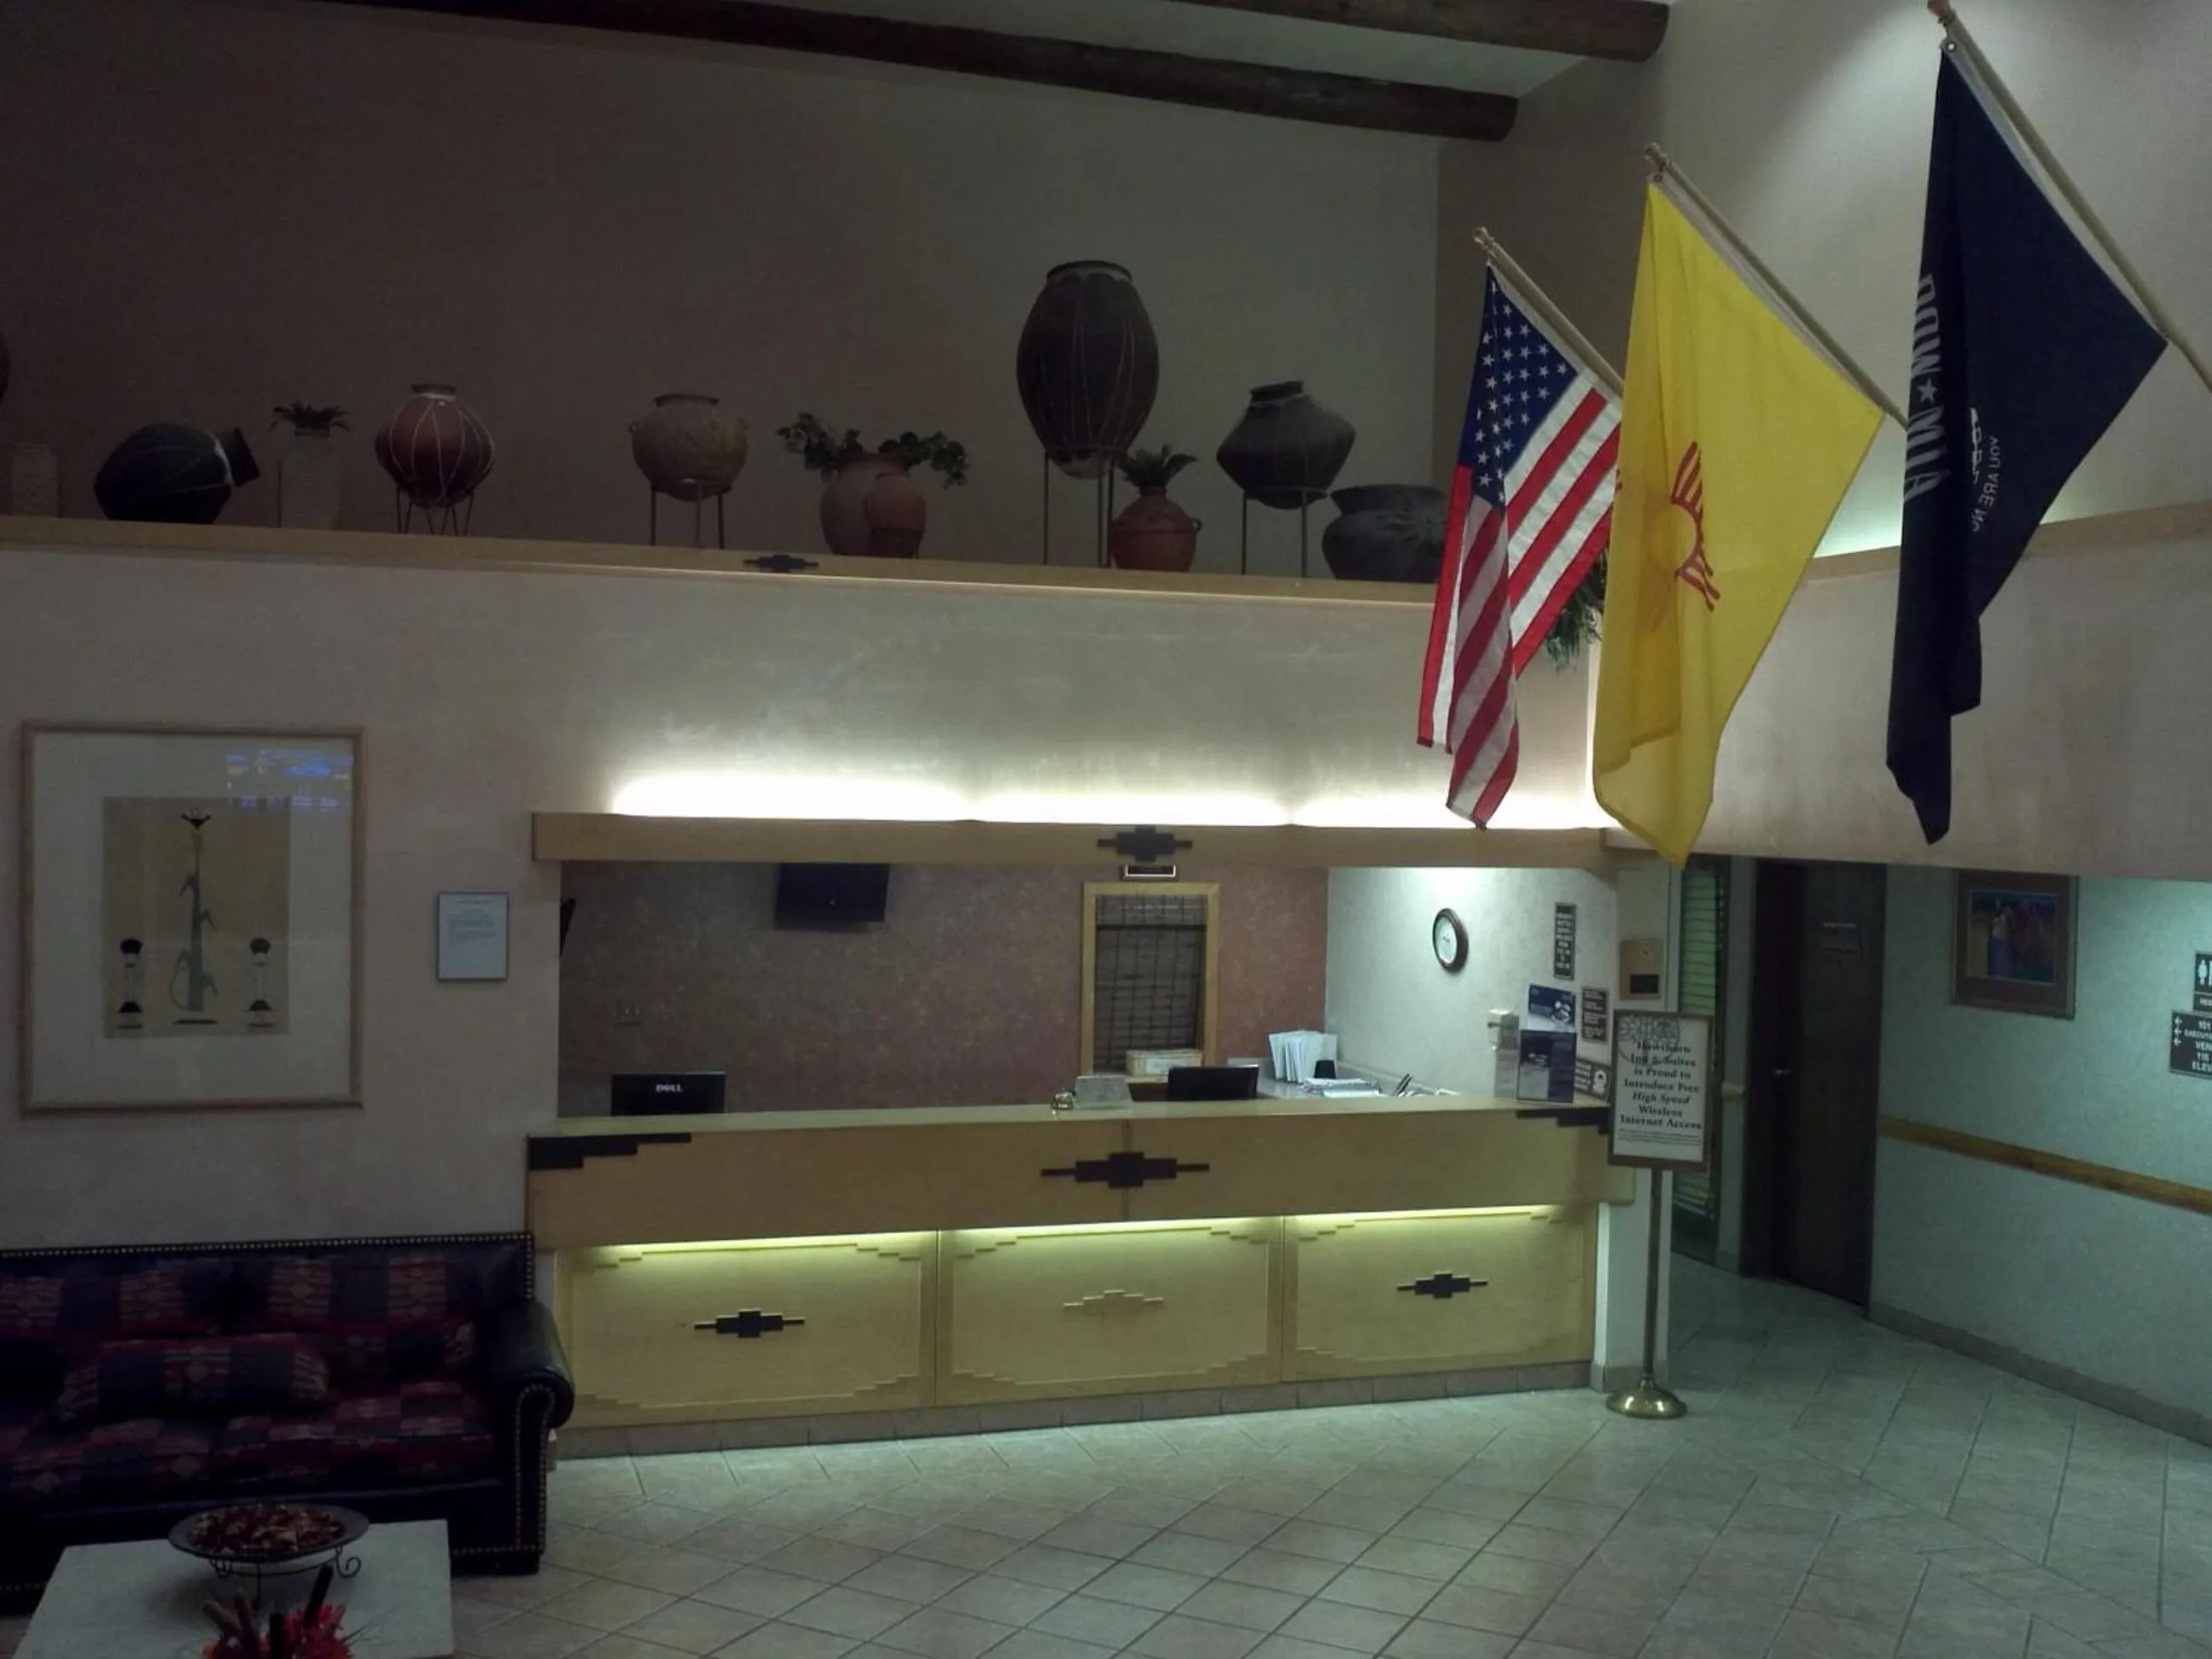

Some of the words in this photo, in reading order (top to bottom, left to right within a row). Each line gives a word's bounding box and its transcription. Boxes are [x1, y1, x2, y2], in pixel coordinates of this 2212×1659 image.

[1664, 1055, 1697, 1067] Suites
[1646, 1068, 1678, 1079] Proud
[1680, 1070, 1692, 1080] to
[1623, 1078, 1674, 1090] Introduce
[1678, 1081, 1700, 1093] Free
[1632, 1091, 1657, 1103] High
[1661, 1093, 1691, 1106] Speed
[1639, 1104, 1684, 1117] Wireless
[1620, 1114, 1663, 1126] Internet
[1666, 1118, 1703, 1130] Access
